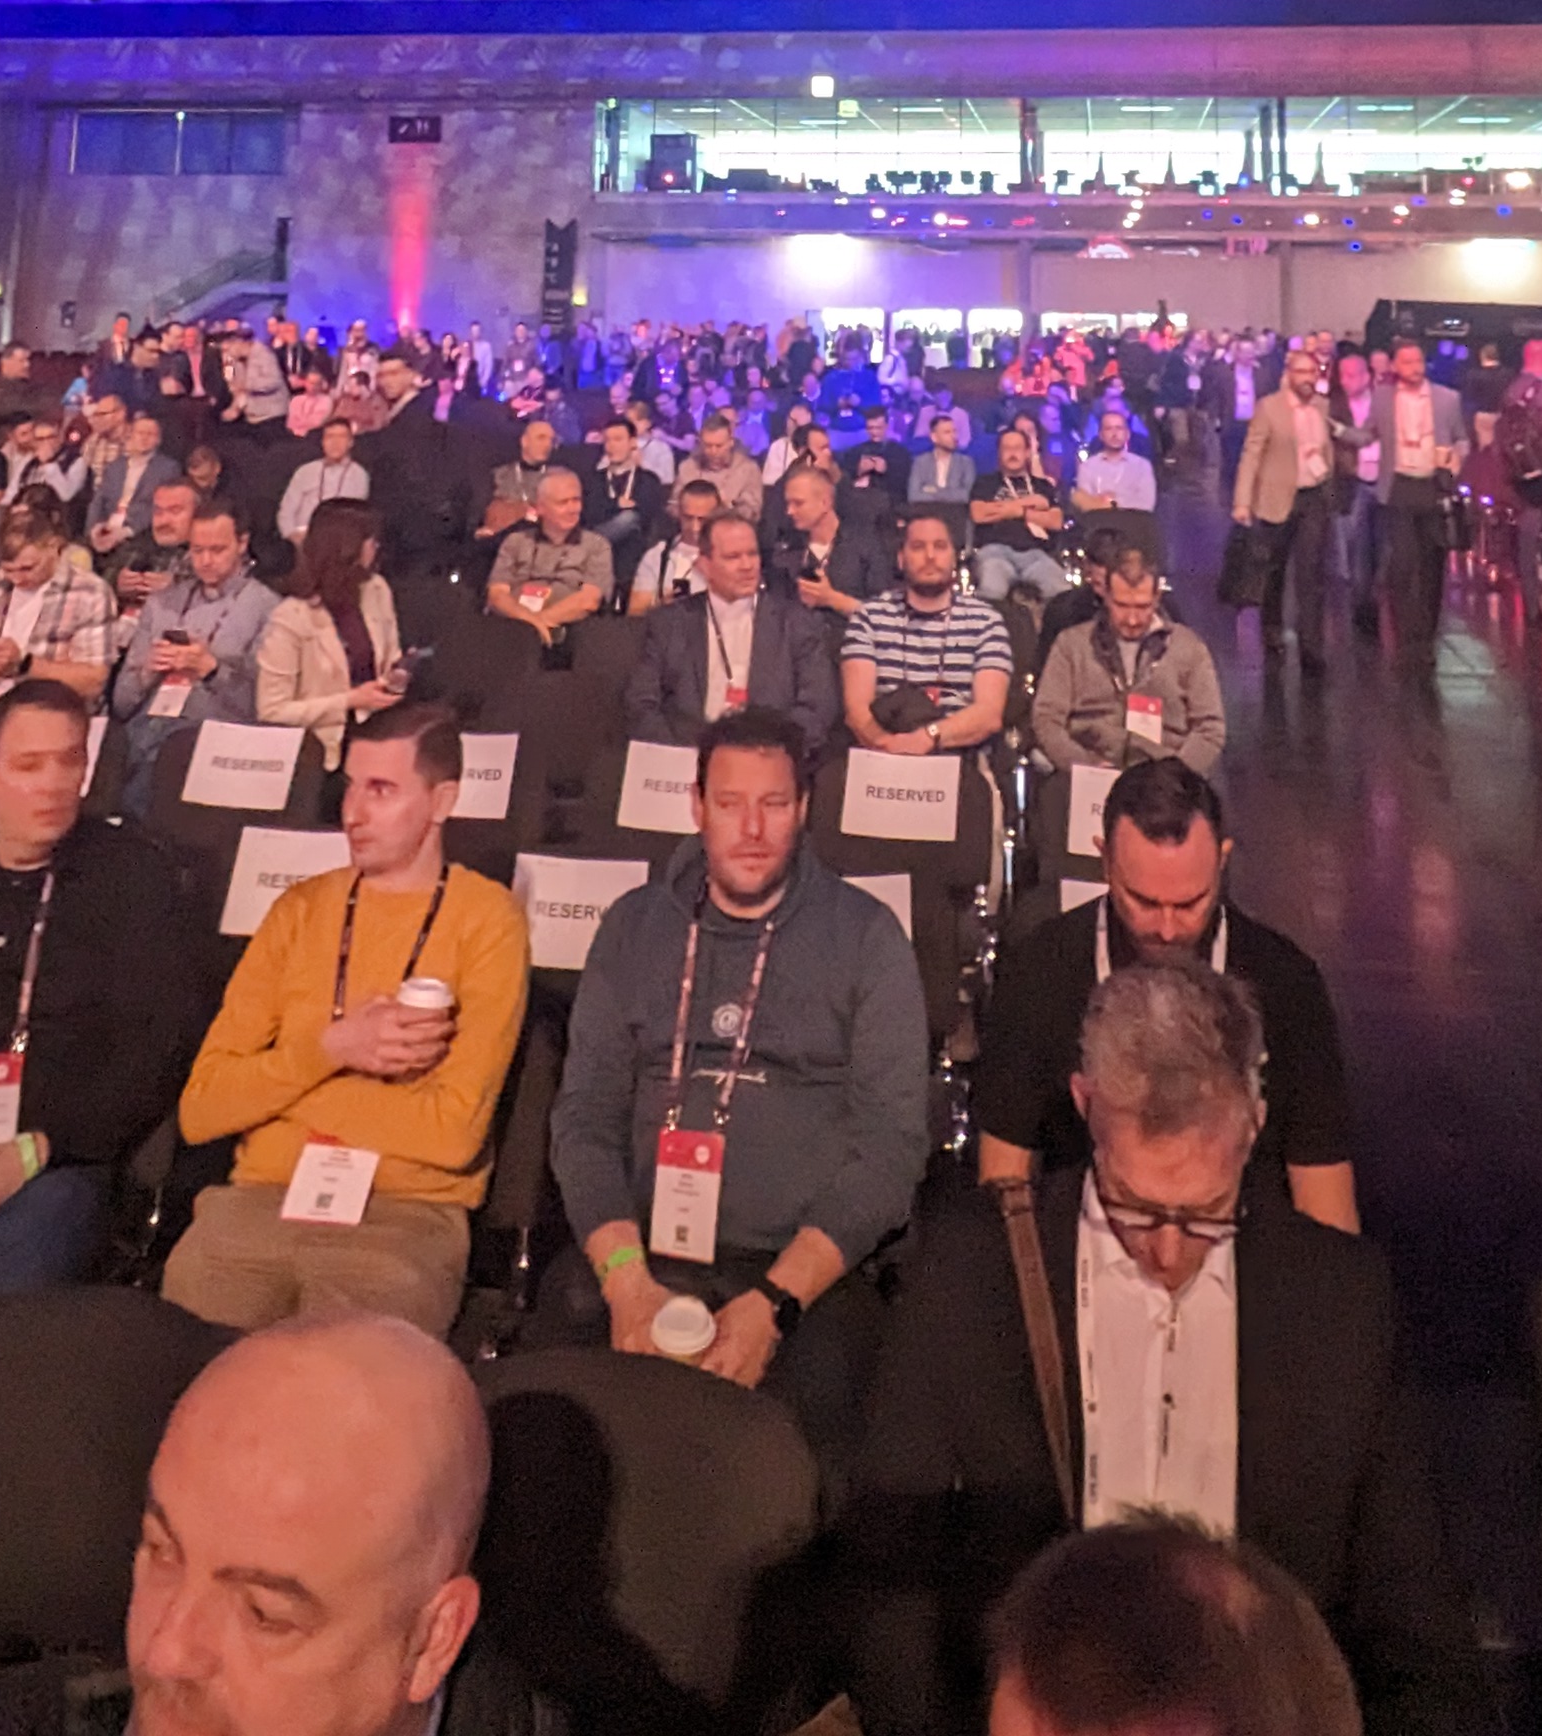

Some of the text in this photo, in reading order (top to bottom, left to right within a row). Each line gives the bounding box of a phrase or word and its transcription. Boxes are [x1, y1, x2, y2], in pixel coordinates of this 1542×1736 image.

[211, 755, 284, 772] RESERVED
[866, 784, 945, 802] RESERVED
[535, 901, 608, 920] RESERV
